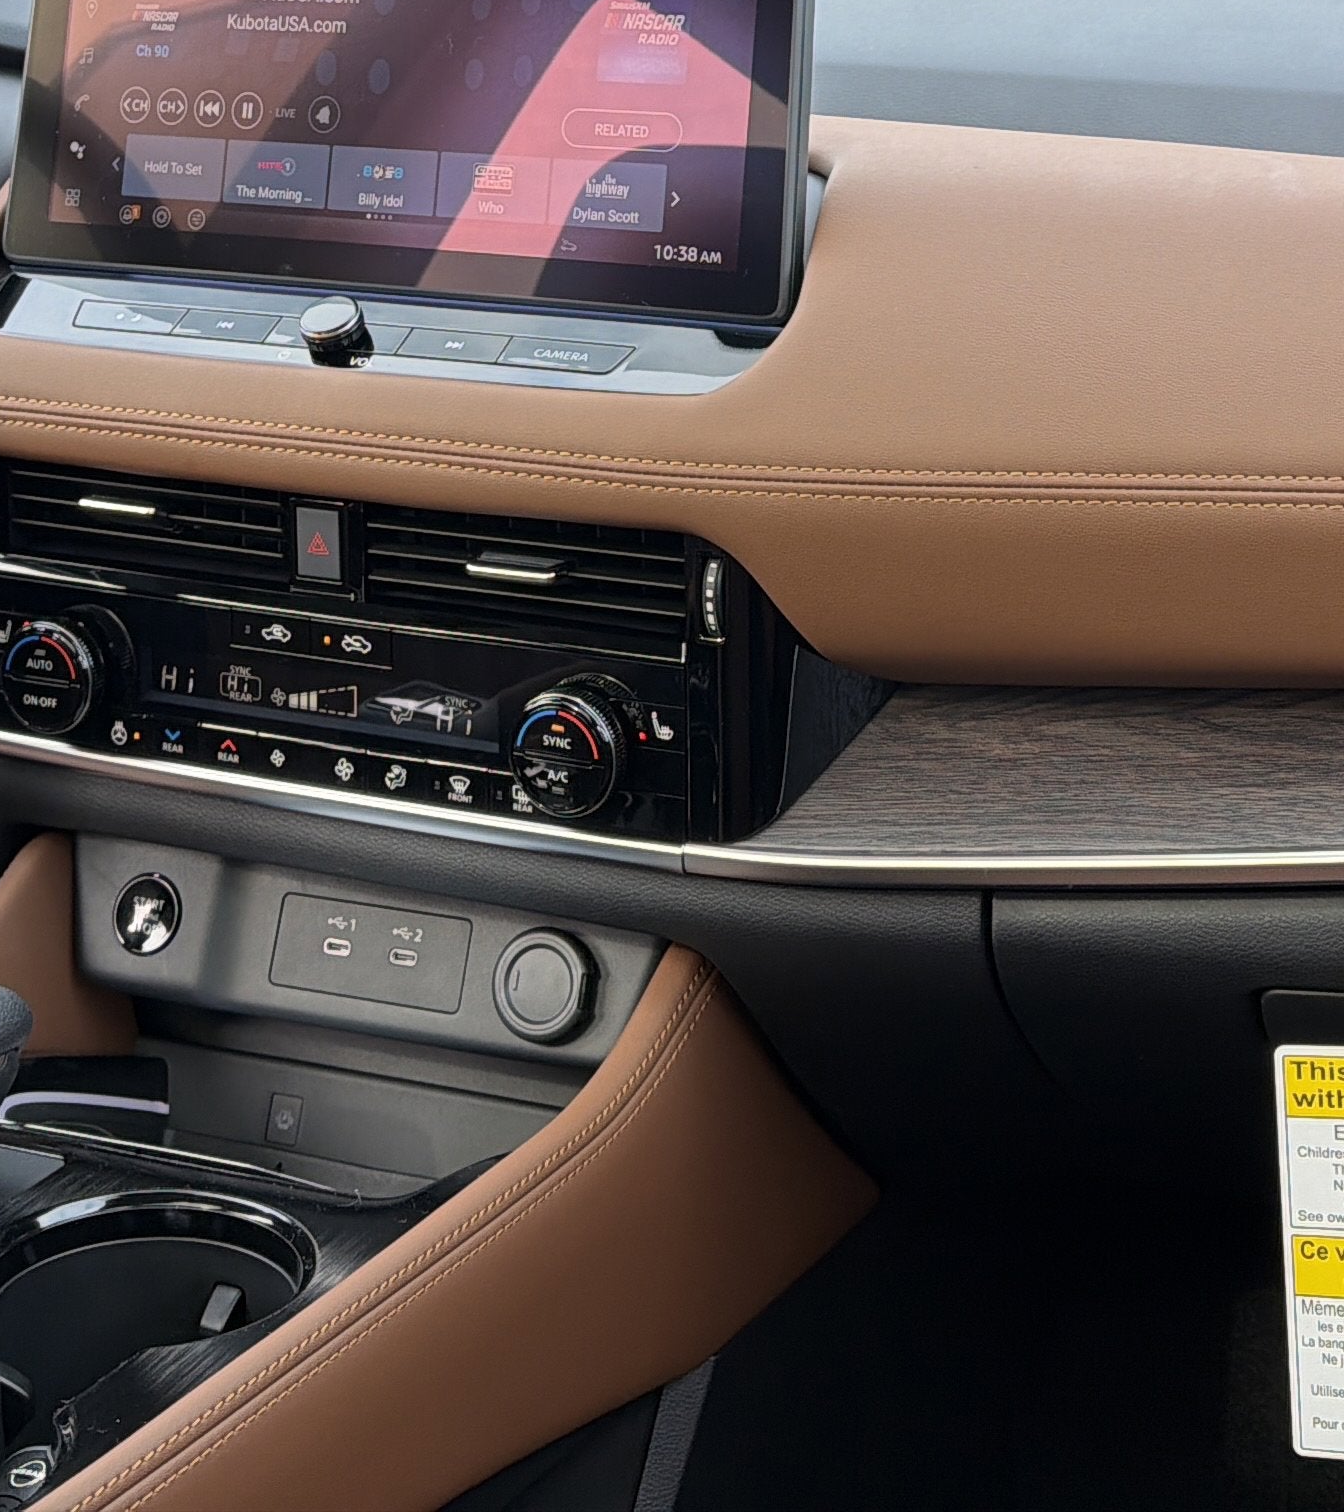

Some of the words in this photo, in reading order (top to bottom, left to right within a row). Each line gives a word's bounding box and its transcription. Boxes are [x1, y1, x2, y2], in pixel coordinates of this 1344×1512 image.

[150, 23, 176, 32] RADIO
[227, 14, 347, 34] KubotaUSA.com
[622, 13, 686, 32] NASCAR
[637, 33, 680, 46] RADIO
[136, 44, 152, 57] Ch
[154, 45, 170, 58] 90
[275, 107, 297, 120] LIVE
[594, 123, 649, 138] RELATED
[144, 160, 169, 173] Hold
[170, 161, 184, 174] To
[184, 162, 203, 176] Set
[236, 185, 256, 198] The
[258, 186, 303, 204] Morning
[585, 177, 630, 200] highway
[358, 192, 381, 209] Billy
[383, 194, 404, 208] Idol
[478, 200, 504, 214] Who
[573, 207, 605, 223] Dylan
[608, 209, 640, 224] Scott
[653, 244, 698, 263] 10:38
[699, 250, 723, 265] AM
[349, 354, 374, 368] VOL
[532, 347, 589, 363] CAMERA
[25, 657, 54, 672] AUTO
[229, 664, 253, 676] SYNC
[161, 664, 195, 694] Hi
[229, 691, 254, 703] REAR
[444, 696, 470, 708] SYNC
[162, 742, 184, 754] REAR
[542, 734, 572, 751] SYNC
[217, 751, 240, 764] REAR
[547, 769, 569, 784] A/C
[447, 792, 474, 804] FRONT
[512, 801, 533, 814] REAR
[350, 918, 356, 932] 1
[414, 929, 423, 943] 2
[1297, 1209, 1323, 1222] See
[1300, 1240, 1328, 1260] Ce
[1301, 1299, 1344, 1317] Même
